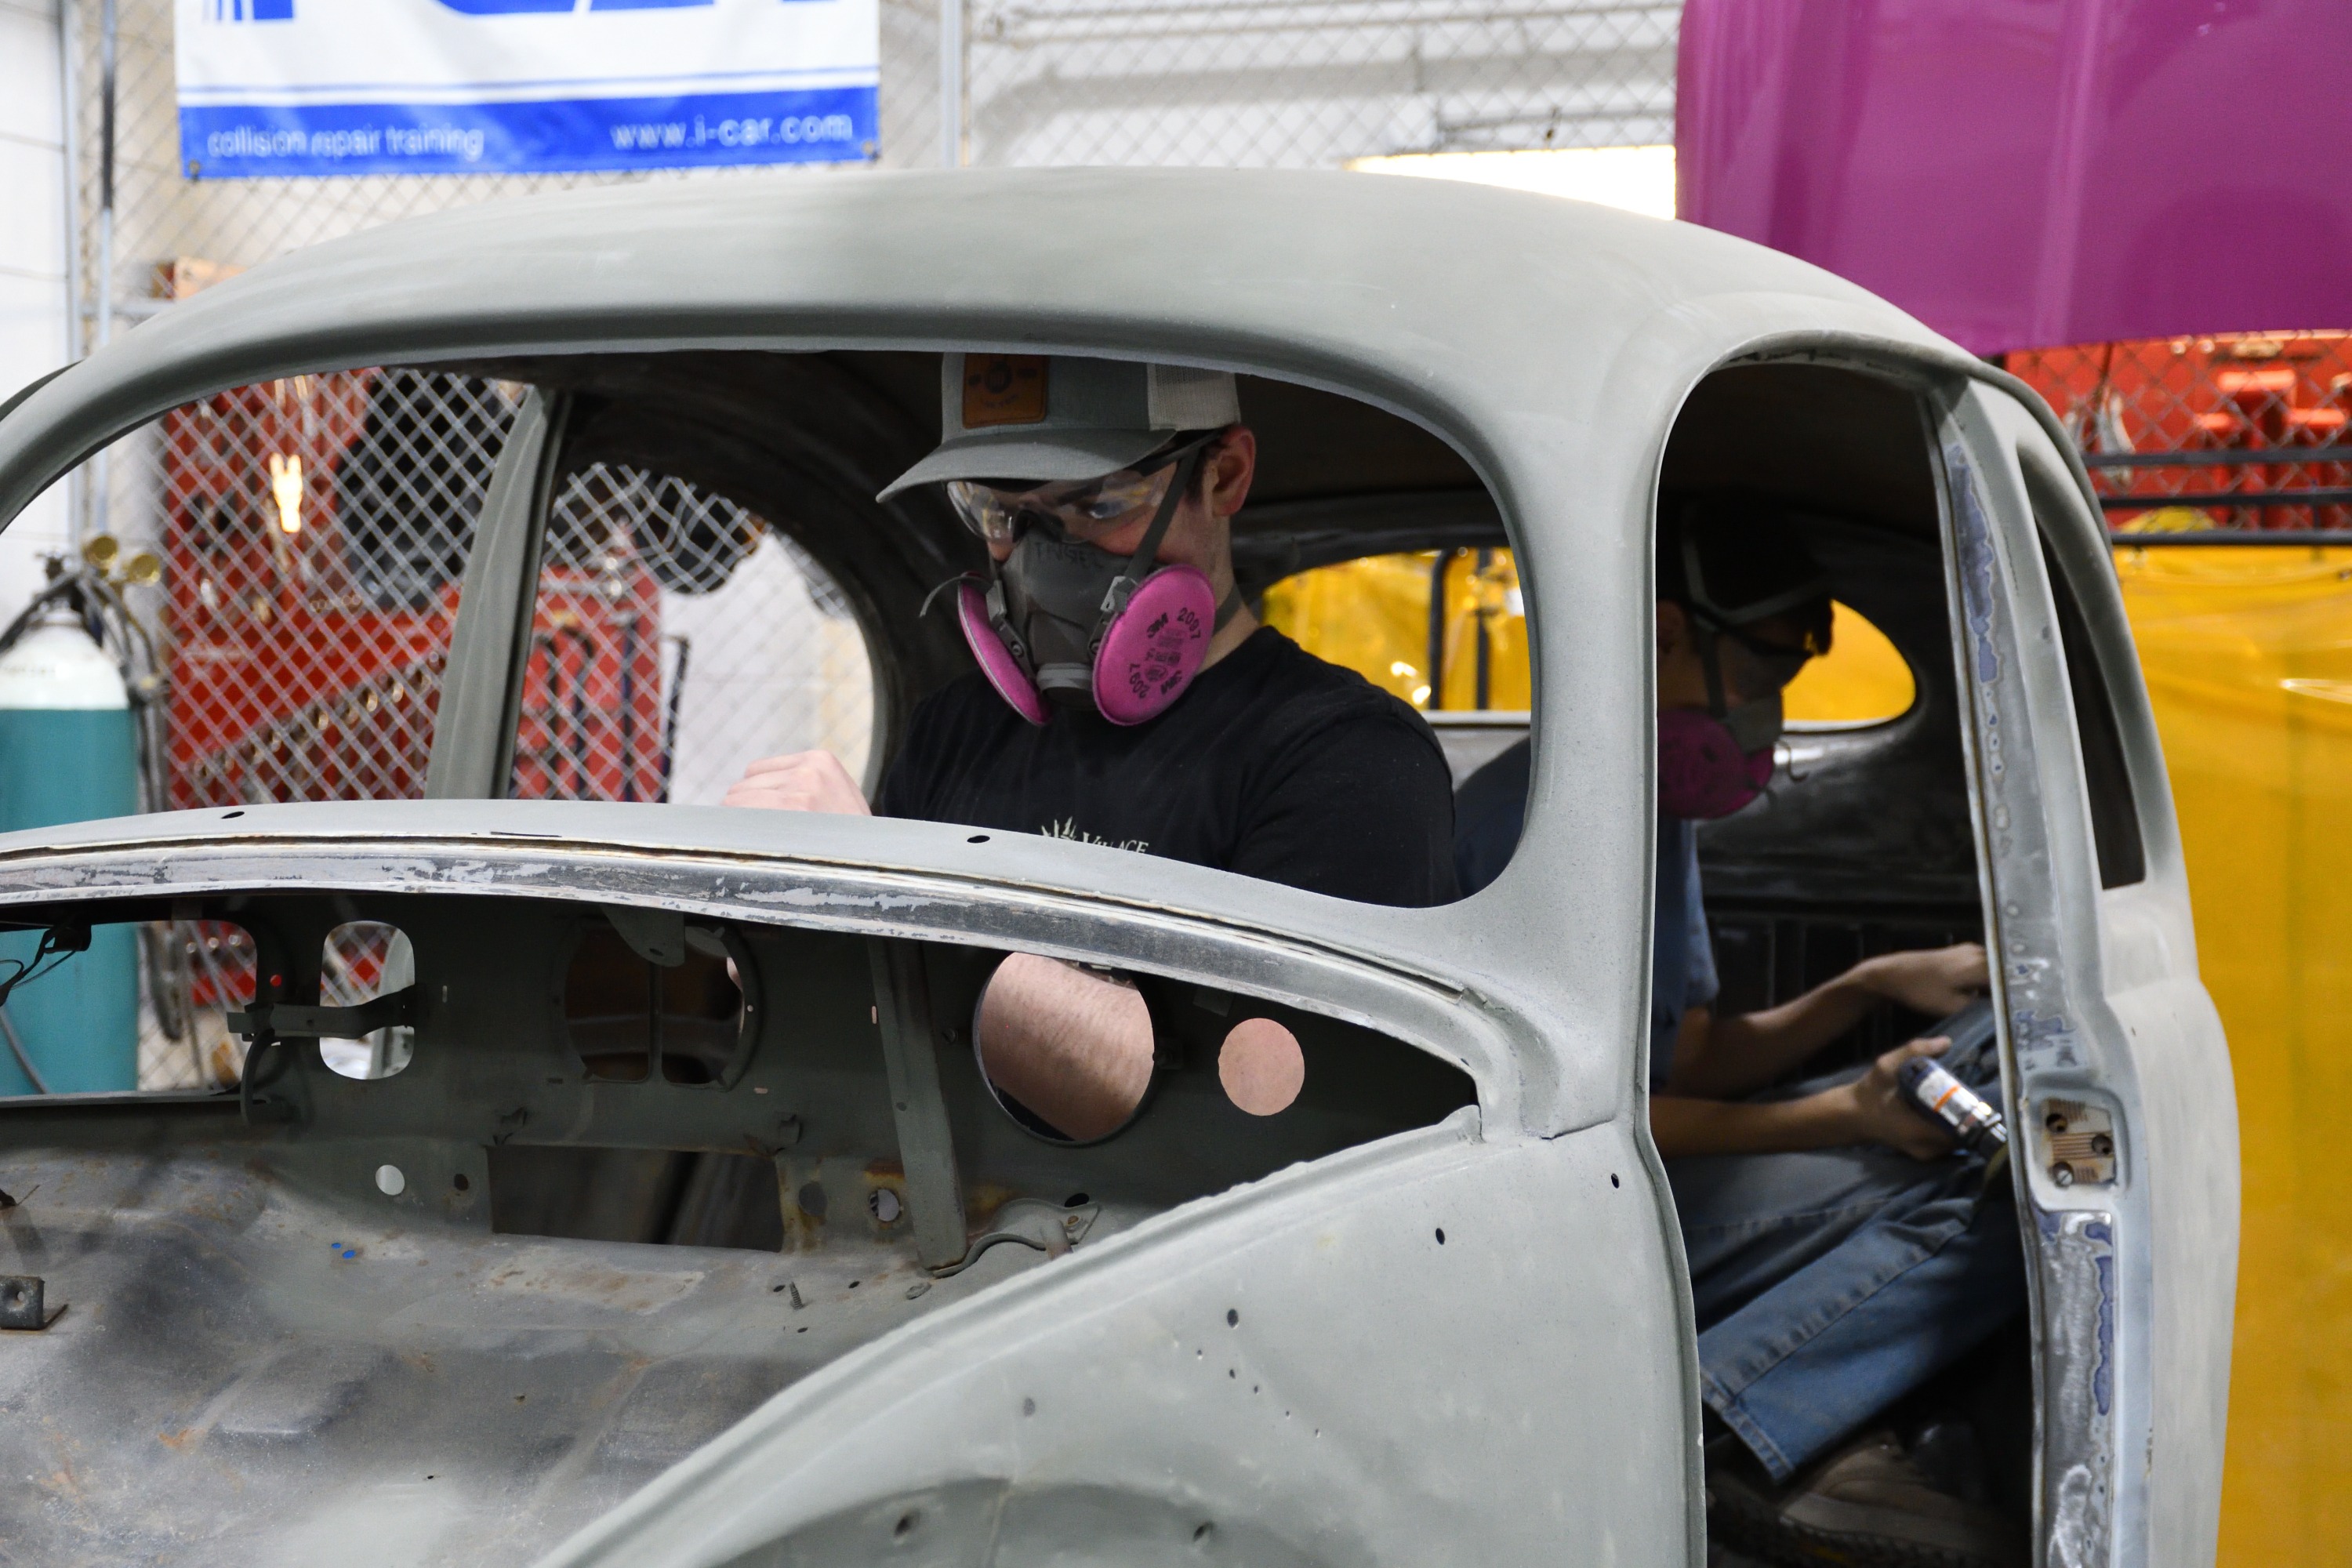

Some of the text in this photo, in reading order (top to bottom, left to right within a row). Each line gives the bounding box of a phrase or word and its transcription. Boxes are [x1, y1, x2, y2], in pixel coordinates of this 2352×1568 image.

[207, 122, 485, 162] collision repair training
[609, 114, 853, 151] www.i-car.com
[1176, 607, 1201, 640] 2097
